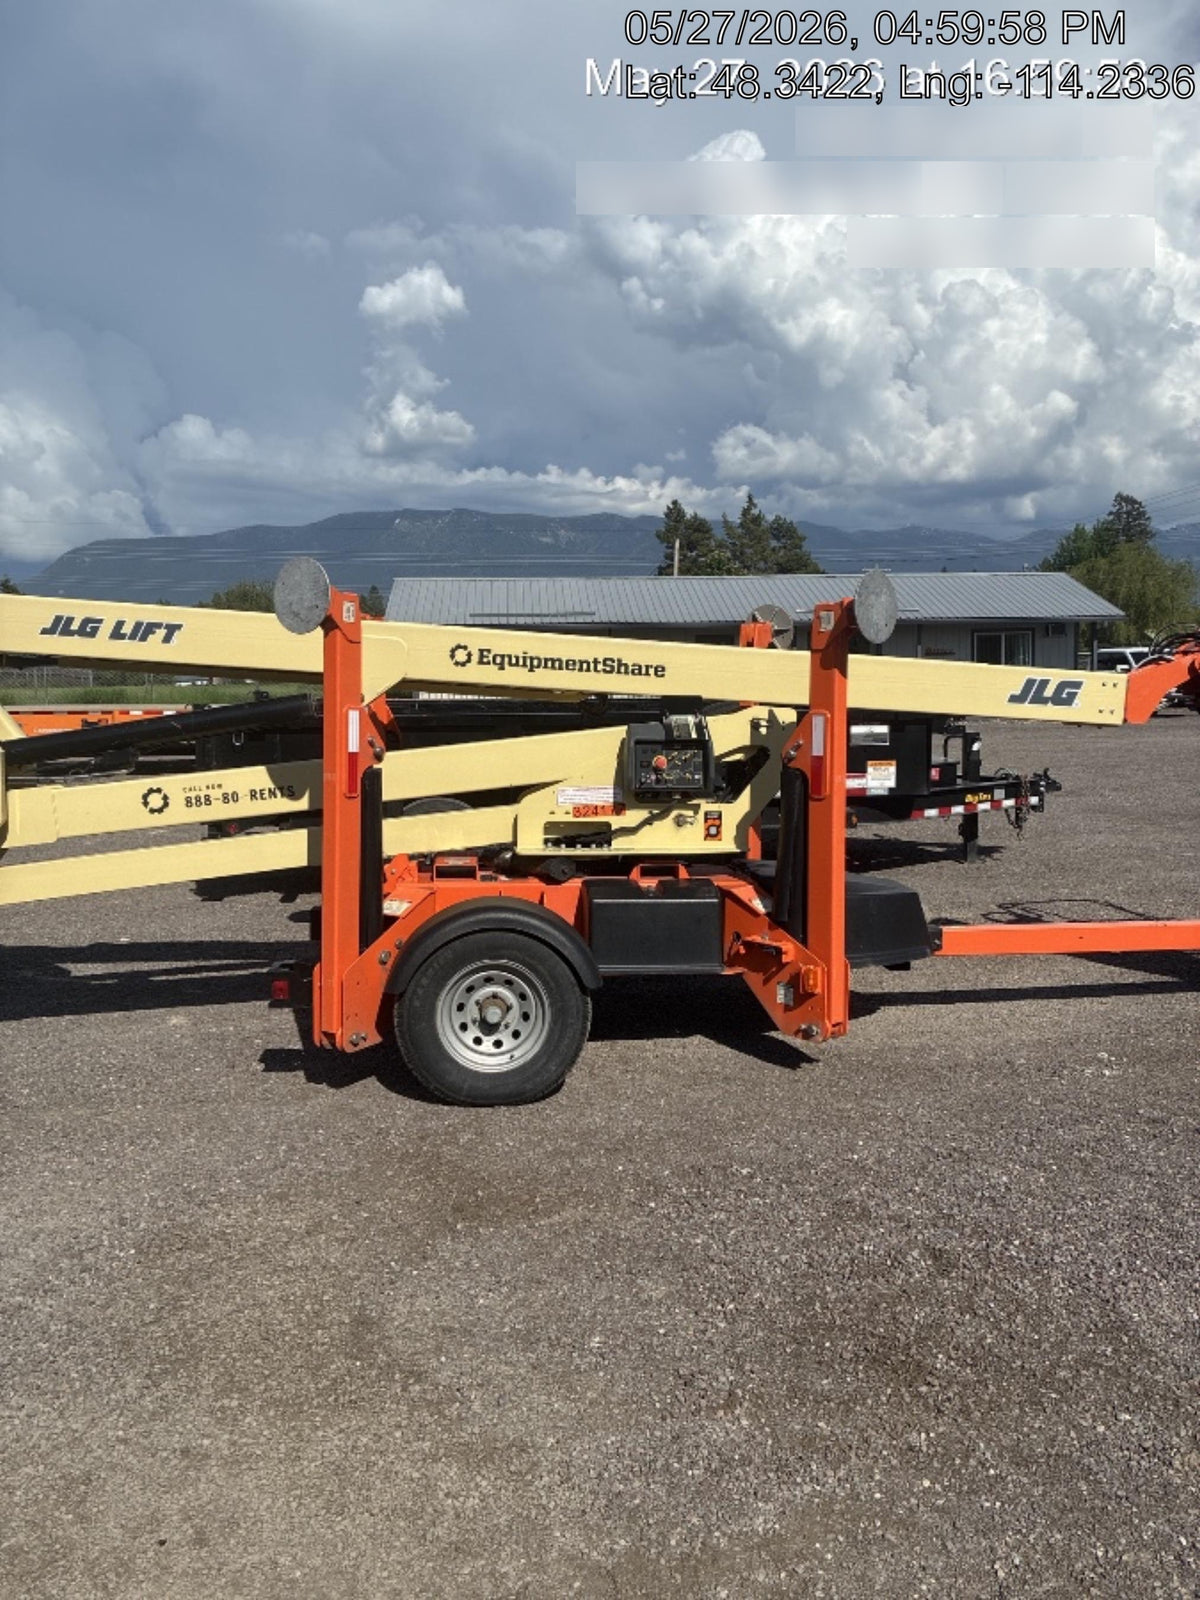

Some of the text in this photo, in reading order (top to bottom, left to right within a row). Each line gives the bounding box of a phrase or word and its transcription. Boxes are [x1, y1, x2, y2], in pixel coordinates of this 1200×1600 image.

[39, 615, 184, 644] JLG LIFT
[477, 648, 667, 678] EquipmentShare
[1007, 677, 1084, 707] JLG
